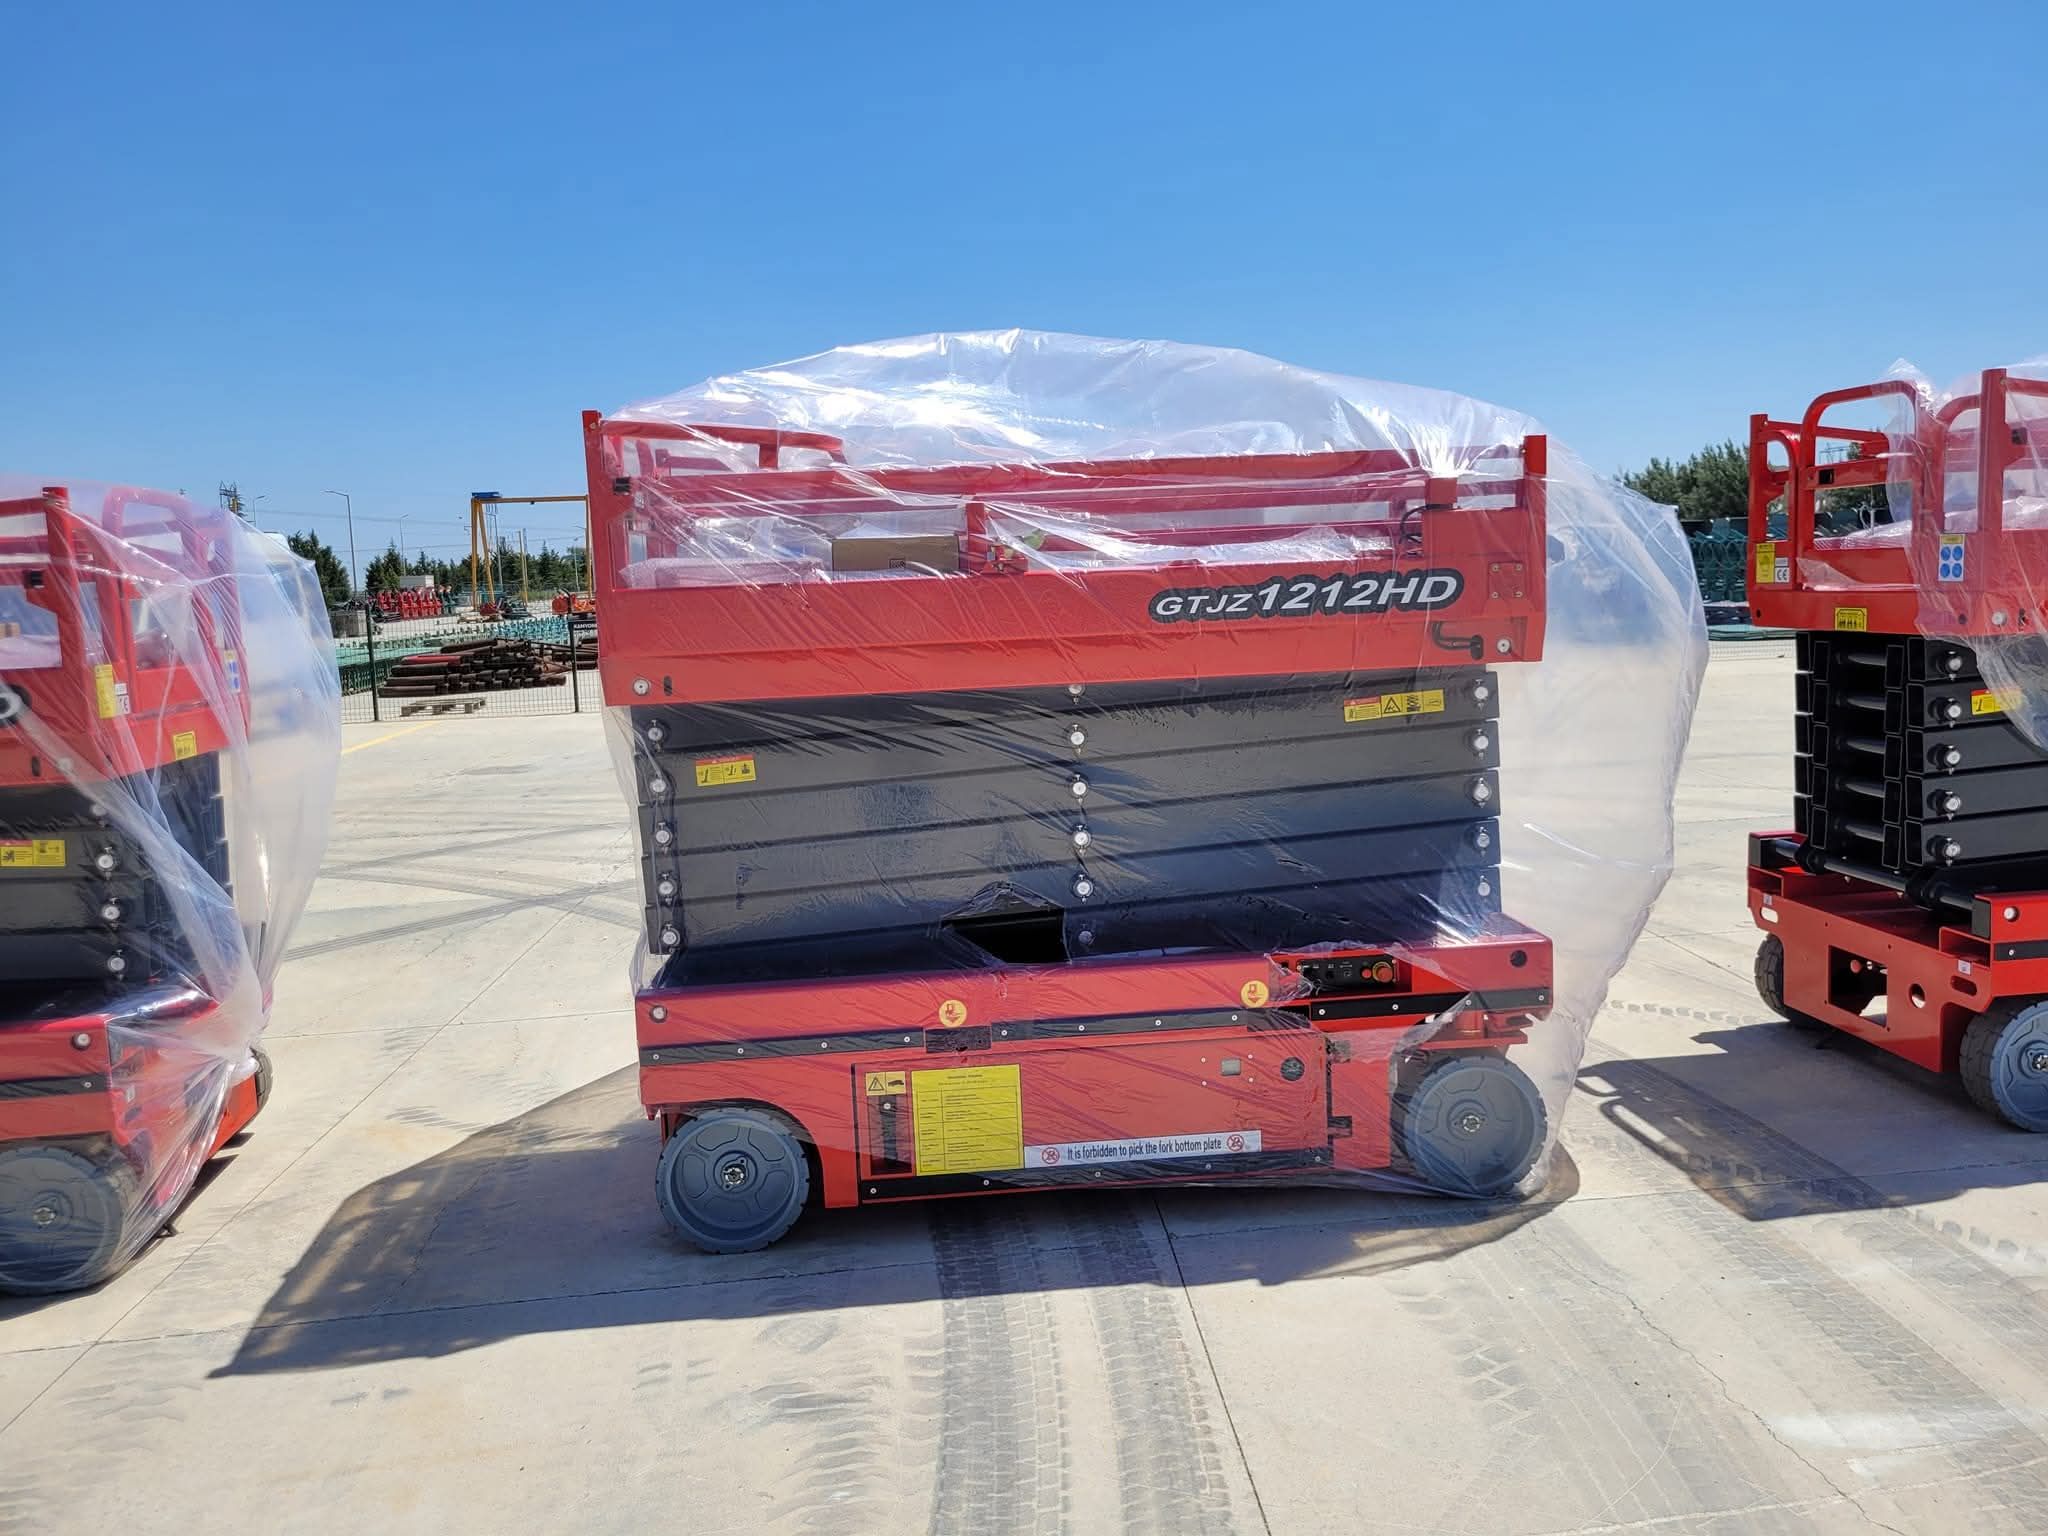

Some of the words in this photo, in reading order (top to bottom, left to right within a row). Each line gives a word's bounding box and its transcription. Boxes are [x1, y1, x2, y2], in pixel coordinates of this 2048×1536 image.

[1155, 575, 1458, 616] GTJZ1212HD
[1067, 1147, 1074, 1160] It
[1074, 1147, 1082, 1160] is
[1082, 1144, 1118, 1159] forbidden
[1118, 1146, 1127, 1156] to
[1128, 1141, 1144, 1158] pick
[1145, 1140, 1158, 1154] the
[1158, 1139, 1174, 1154] fork
[1174, 1138, 1202, 1153] bottom
[1203, 1136, 1222, 1153] plate
